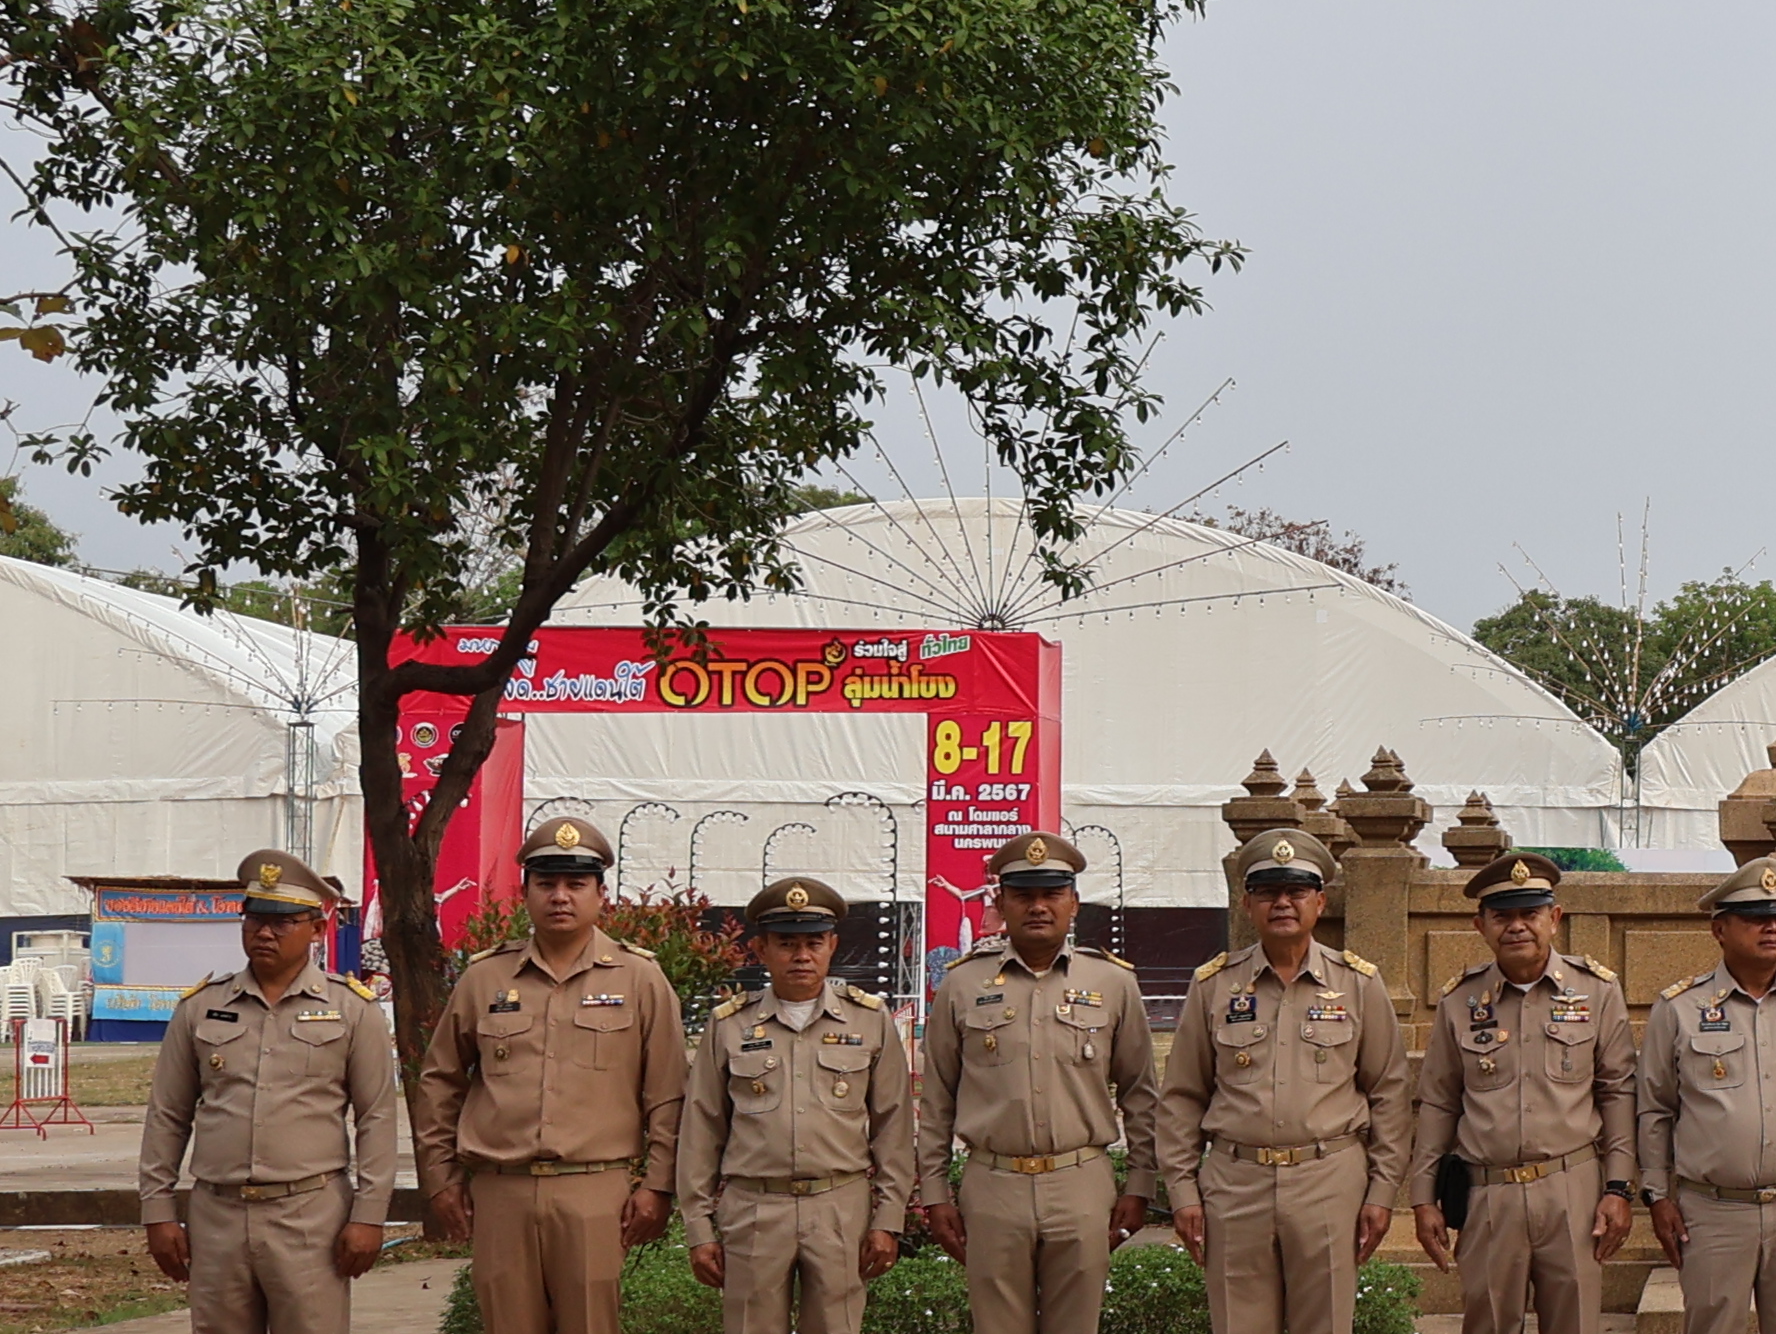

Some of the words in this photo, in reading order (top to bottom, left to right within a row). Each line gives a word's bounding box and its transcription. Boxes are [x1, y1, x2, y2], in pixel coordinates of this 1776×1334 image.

[854, 639, 908, 661] ร่วมใจสู่
[920, 634, 971, 659] ทั่วไทย
[660, 662, 831, 706] OTOP
[842, 662, 957, 707] ลุ่มน้ำโขง
[934, 720, 1032, 774] 8-17
[931, 780, 971, 801] มี.ค.
[977, 784, 1031, 801] 2567
[947, 810, 963, 822] ณ
[969, 806, 1019, 822] โดมแอร์
